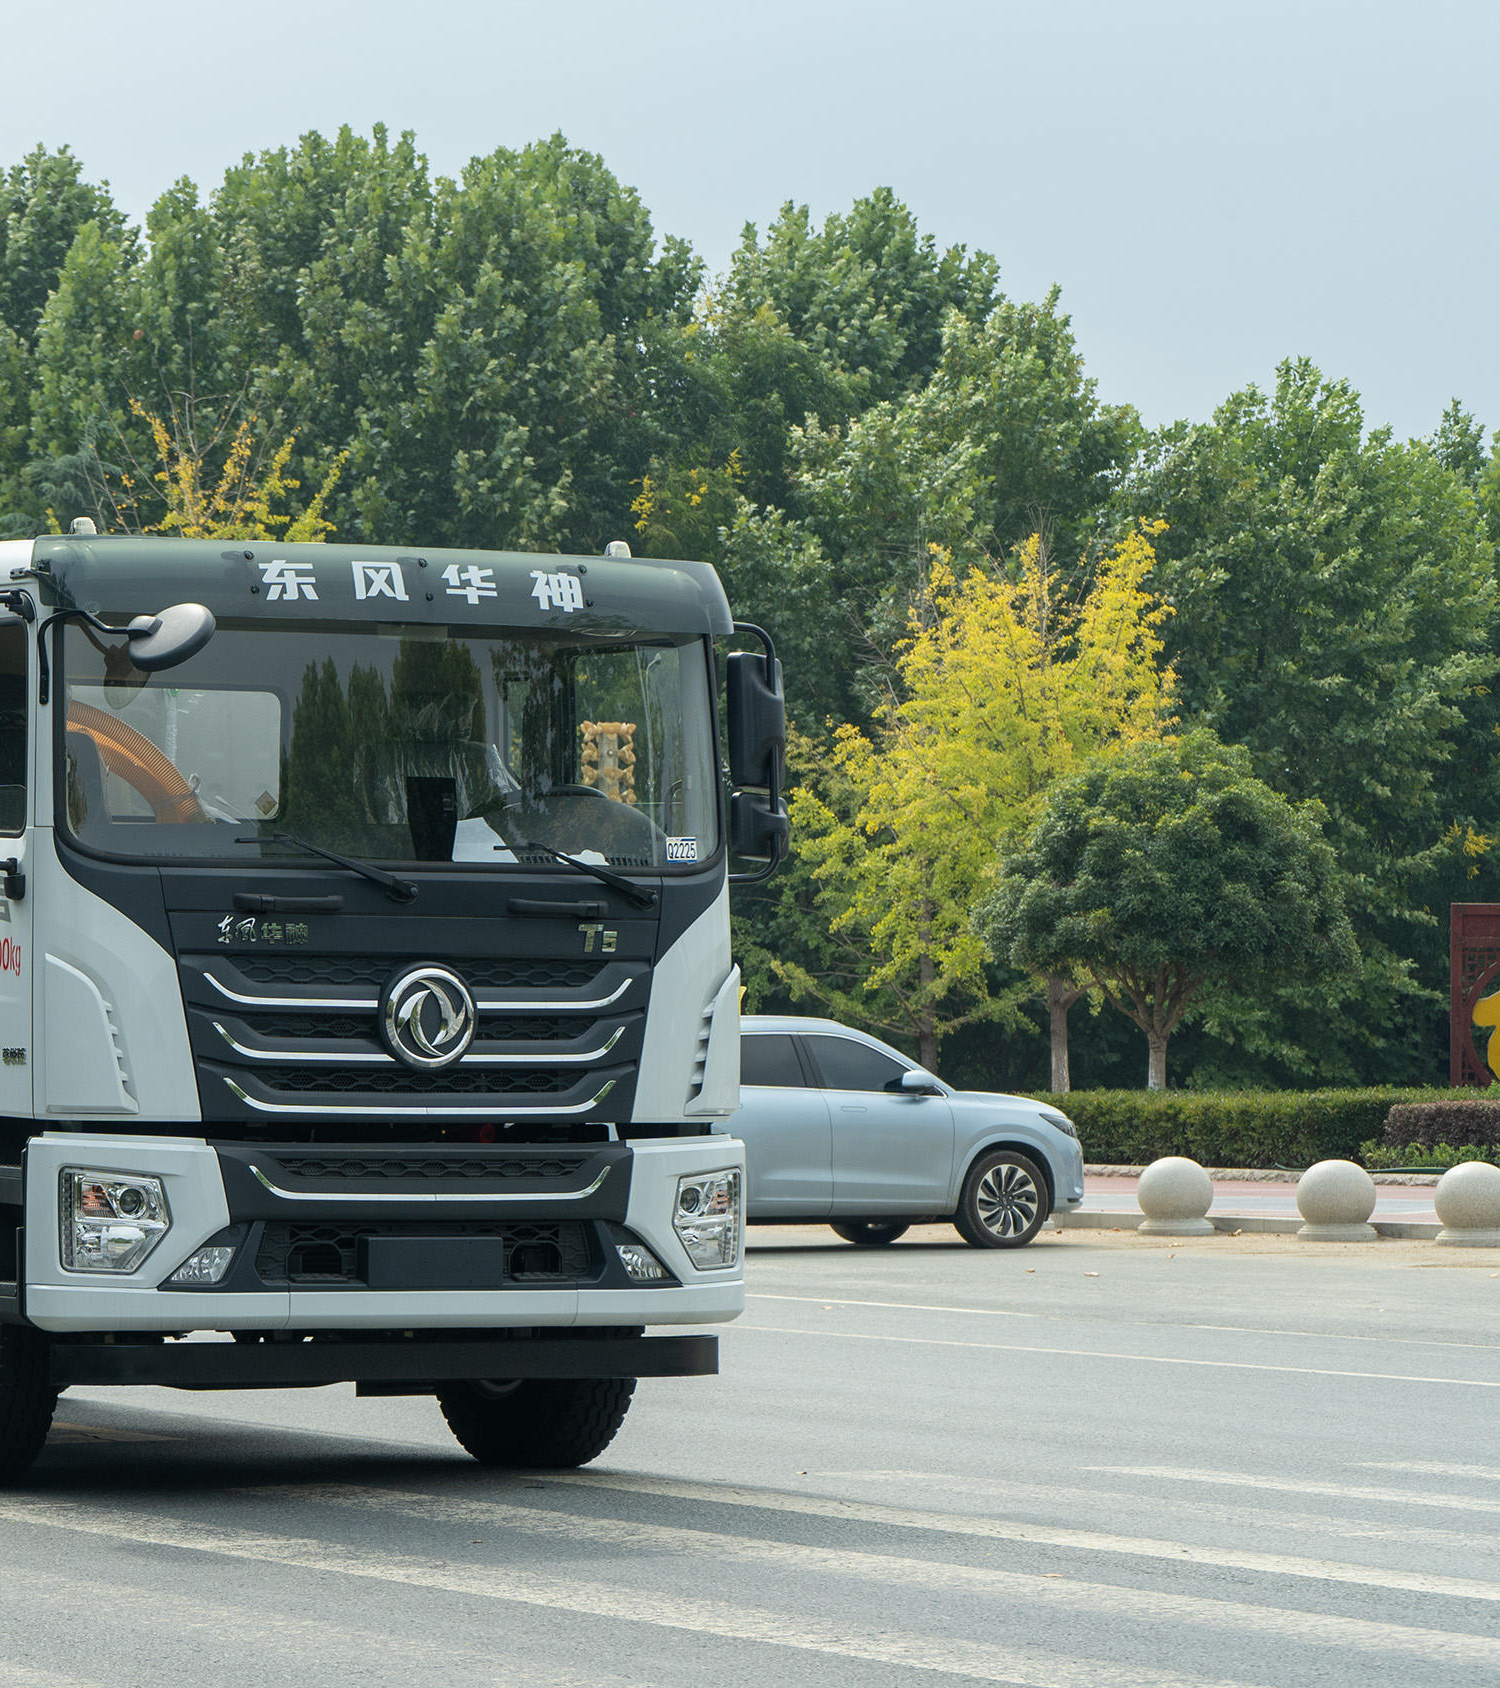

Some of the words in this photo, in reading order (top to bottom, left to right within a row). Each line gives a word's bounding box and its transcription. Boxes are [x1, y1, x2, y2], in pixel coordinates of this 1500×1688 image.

[258, 559, 584, 613] 东风华神
[667, 843, 696, 859] Q2225
[578, 923, 618, 952] T5
